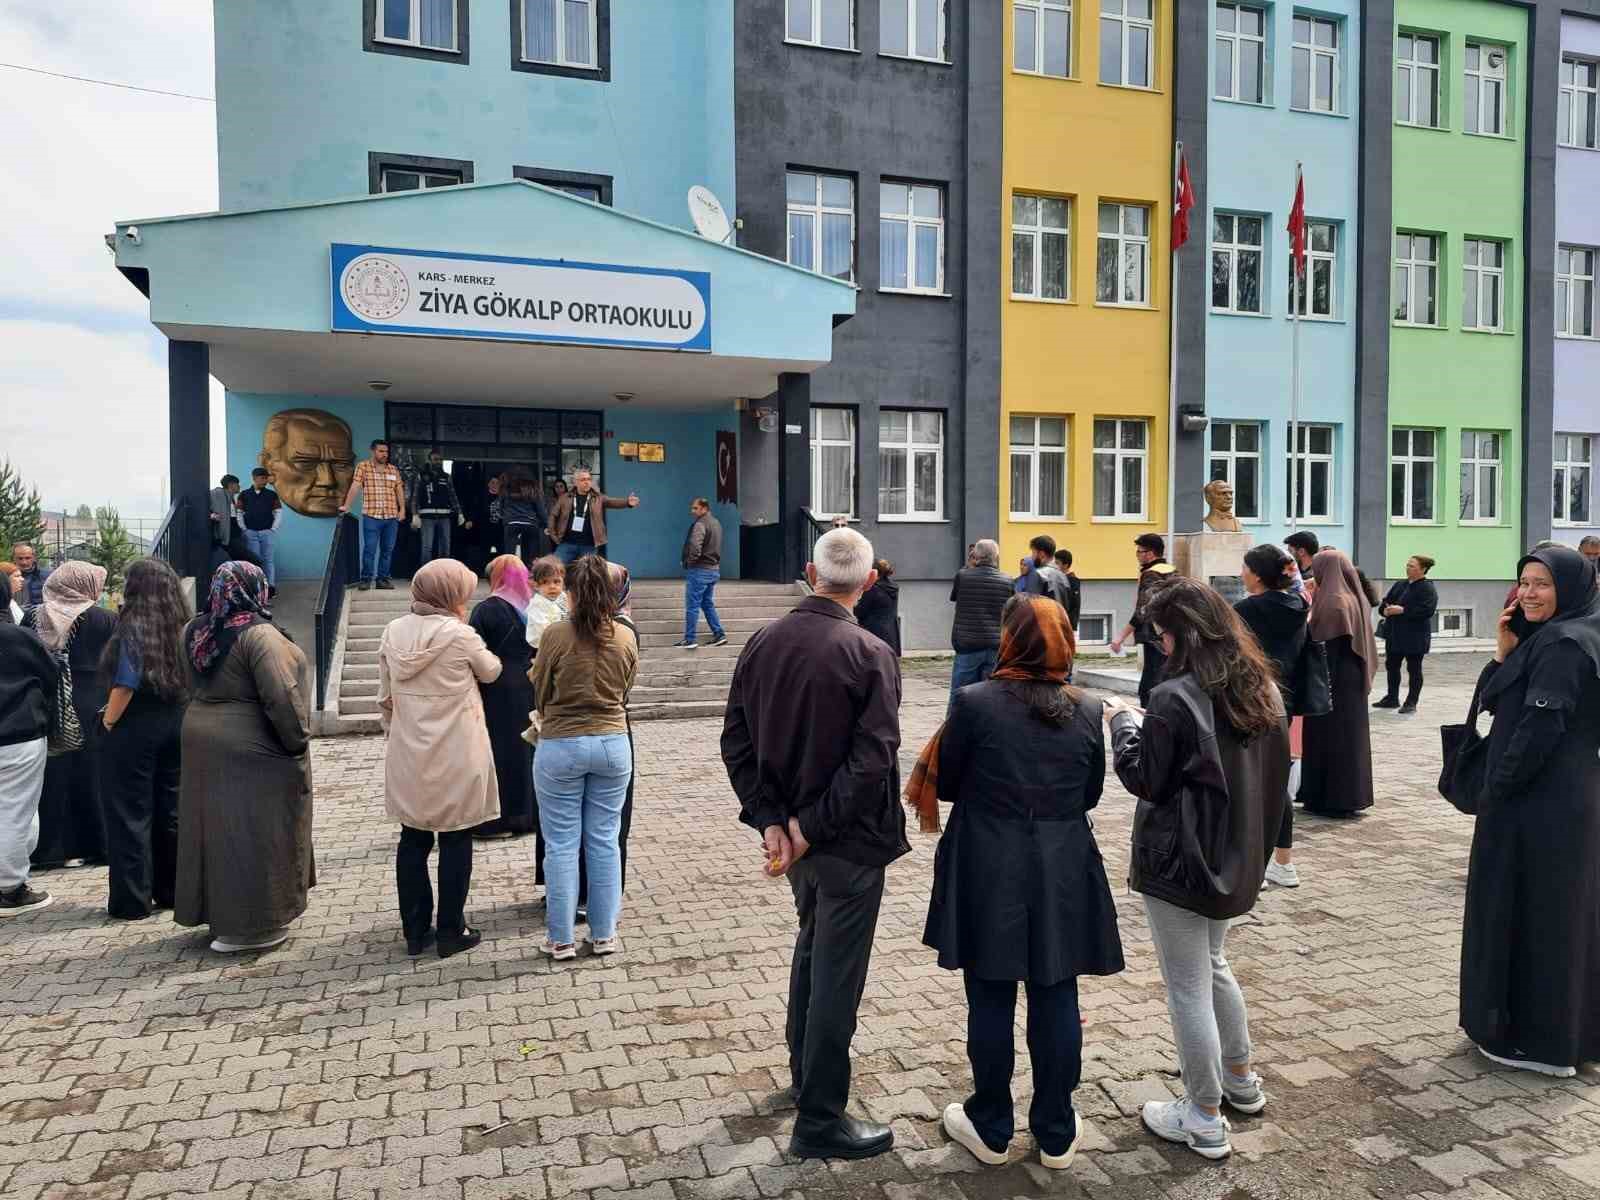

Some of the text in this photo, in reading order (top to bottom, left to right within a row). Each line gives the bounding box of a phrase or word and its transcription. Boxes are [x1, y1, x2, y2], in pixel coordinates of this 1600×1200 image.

[418, 272, 446, 282] KARS
[454, 274, 496, 286] MERKEZ
[418, 288, 469, 315] ZİYA
[473, 292, 563, 320] GÖKALP
[568, 302, 692, 329] ORTAOKULU
